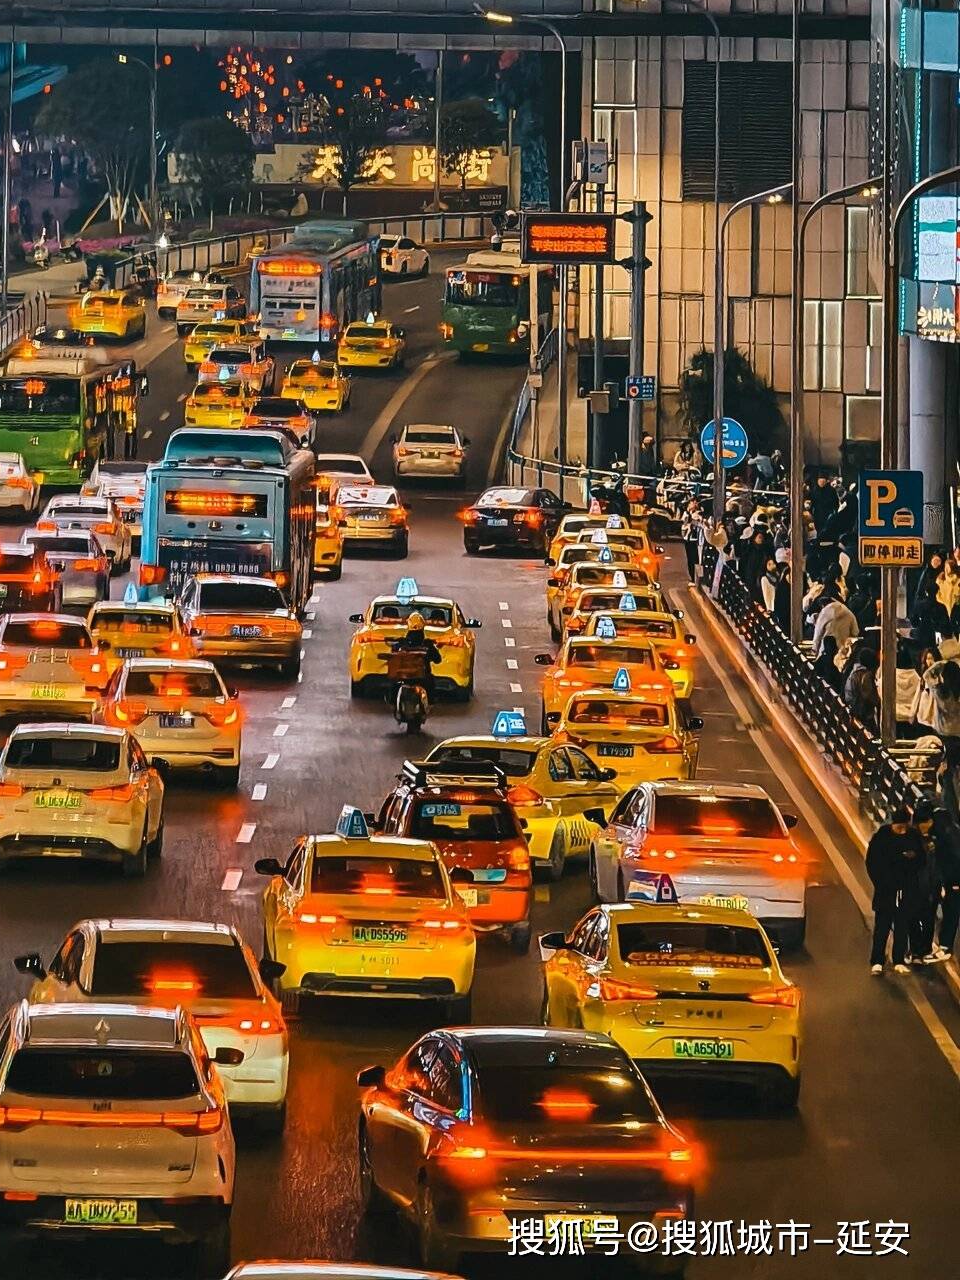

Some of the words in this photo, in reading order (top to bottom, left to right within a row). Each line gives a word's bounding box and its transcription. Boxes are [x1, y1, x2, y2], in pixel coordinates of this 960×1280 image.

[866, 479, 897, 527] P
[863, 544, 920, 560] 即停即走
